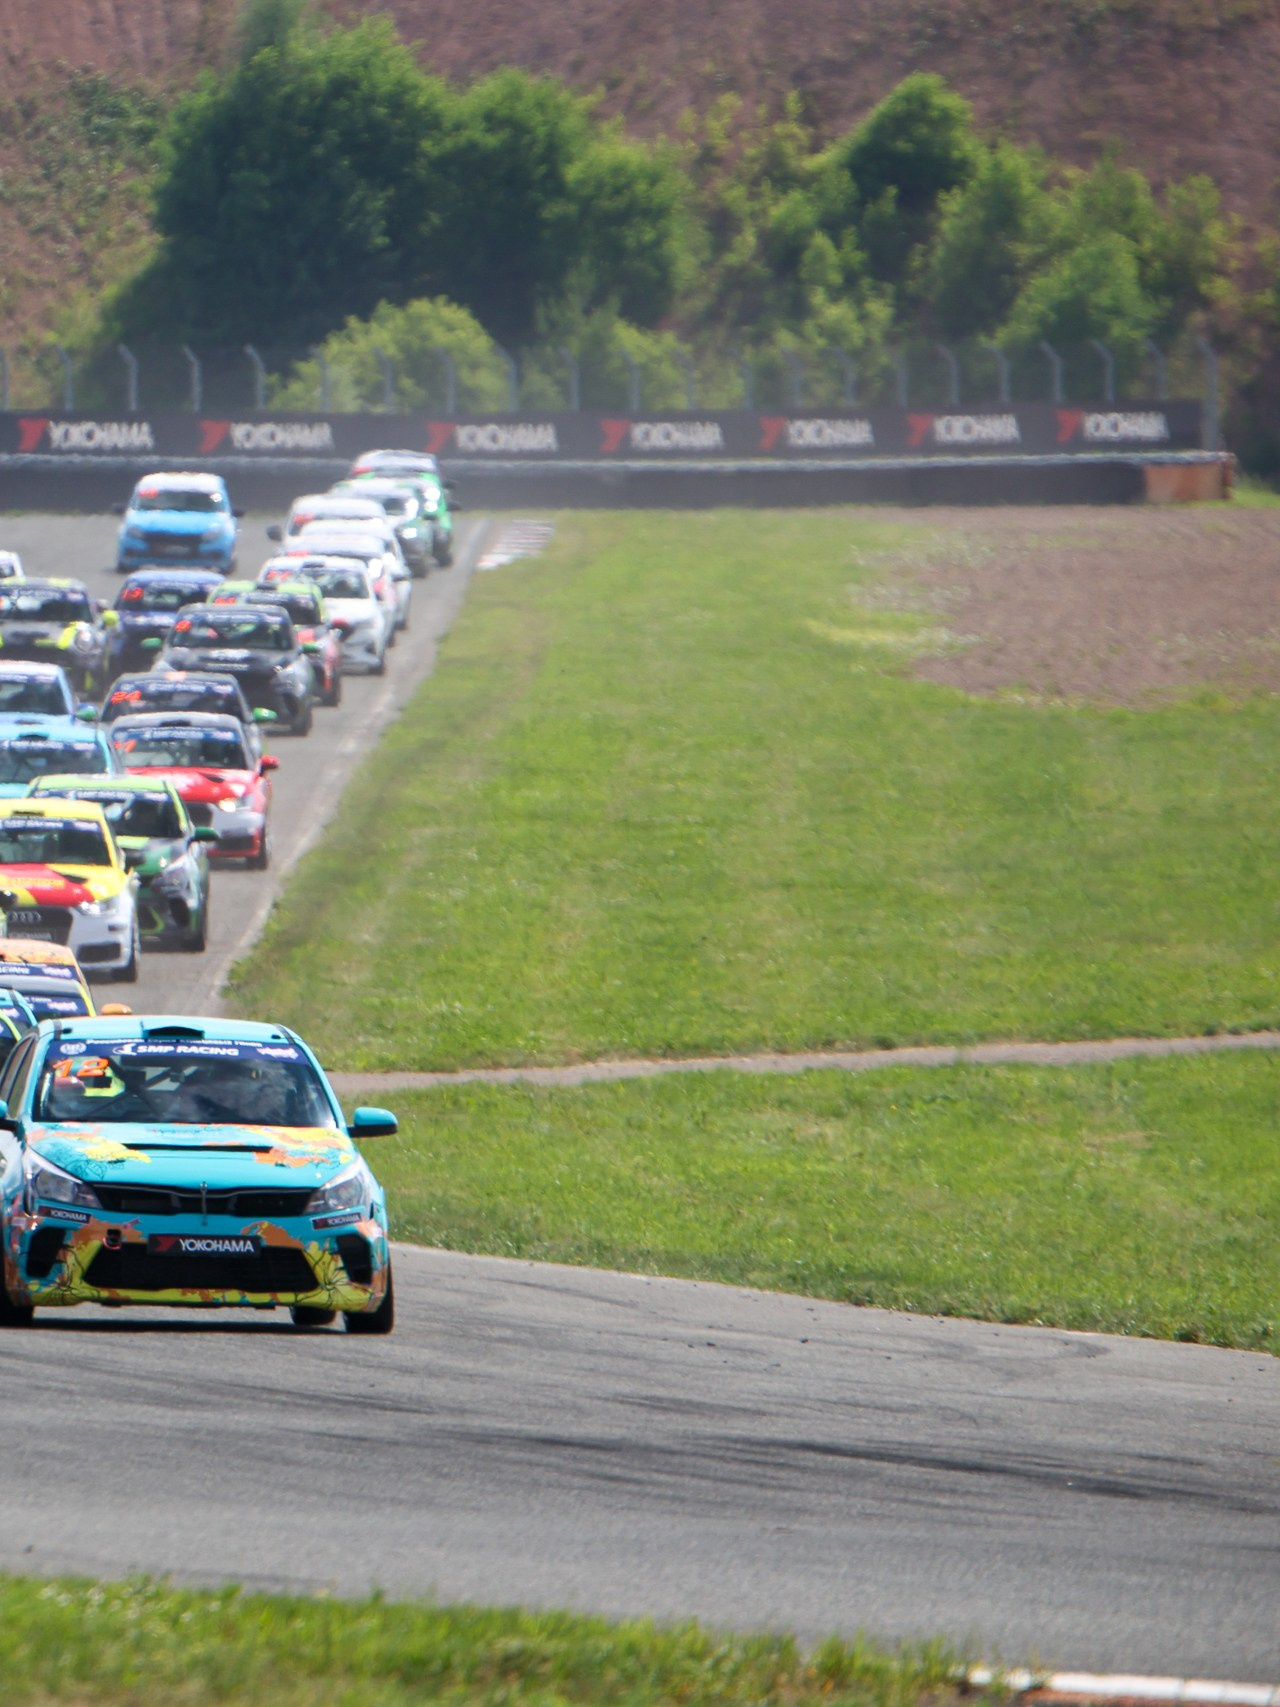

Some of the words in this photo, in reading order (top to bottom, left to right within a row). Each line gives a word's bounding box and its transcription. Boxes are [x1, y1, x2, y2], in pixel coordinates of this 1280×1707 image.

[137, 1045, 175, 1053] SMP
[176, 1045, 239, 1056] RACING
[52, 1057, 109, 1078] 12
[50, 1209, 88, 1221] YOKOHAMA
[327, 1215, 361, 1225] YOKOHAMA
[178, 1238, 255, 1253] YOKOHAMA
